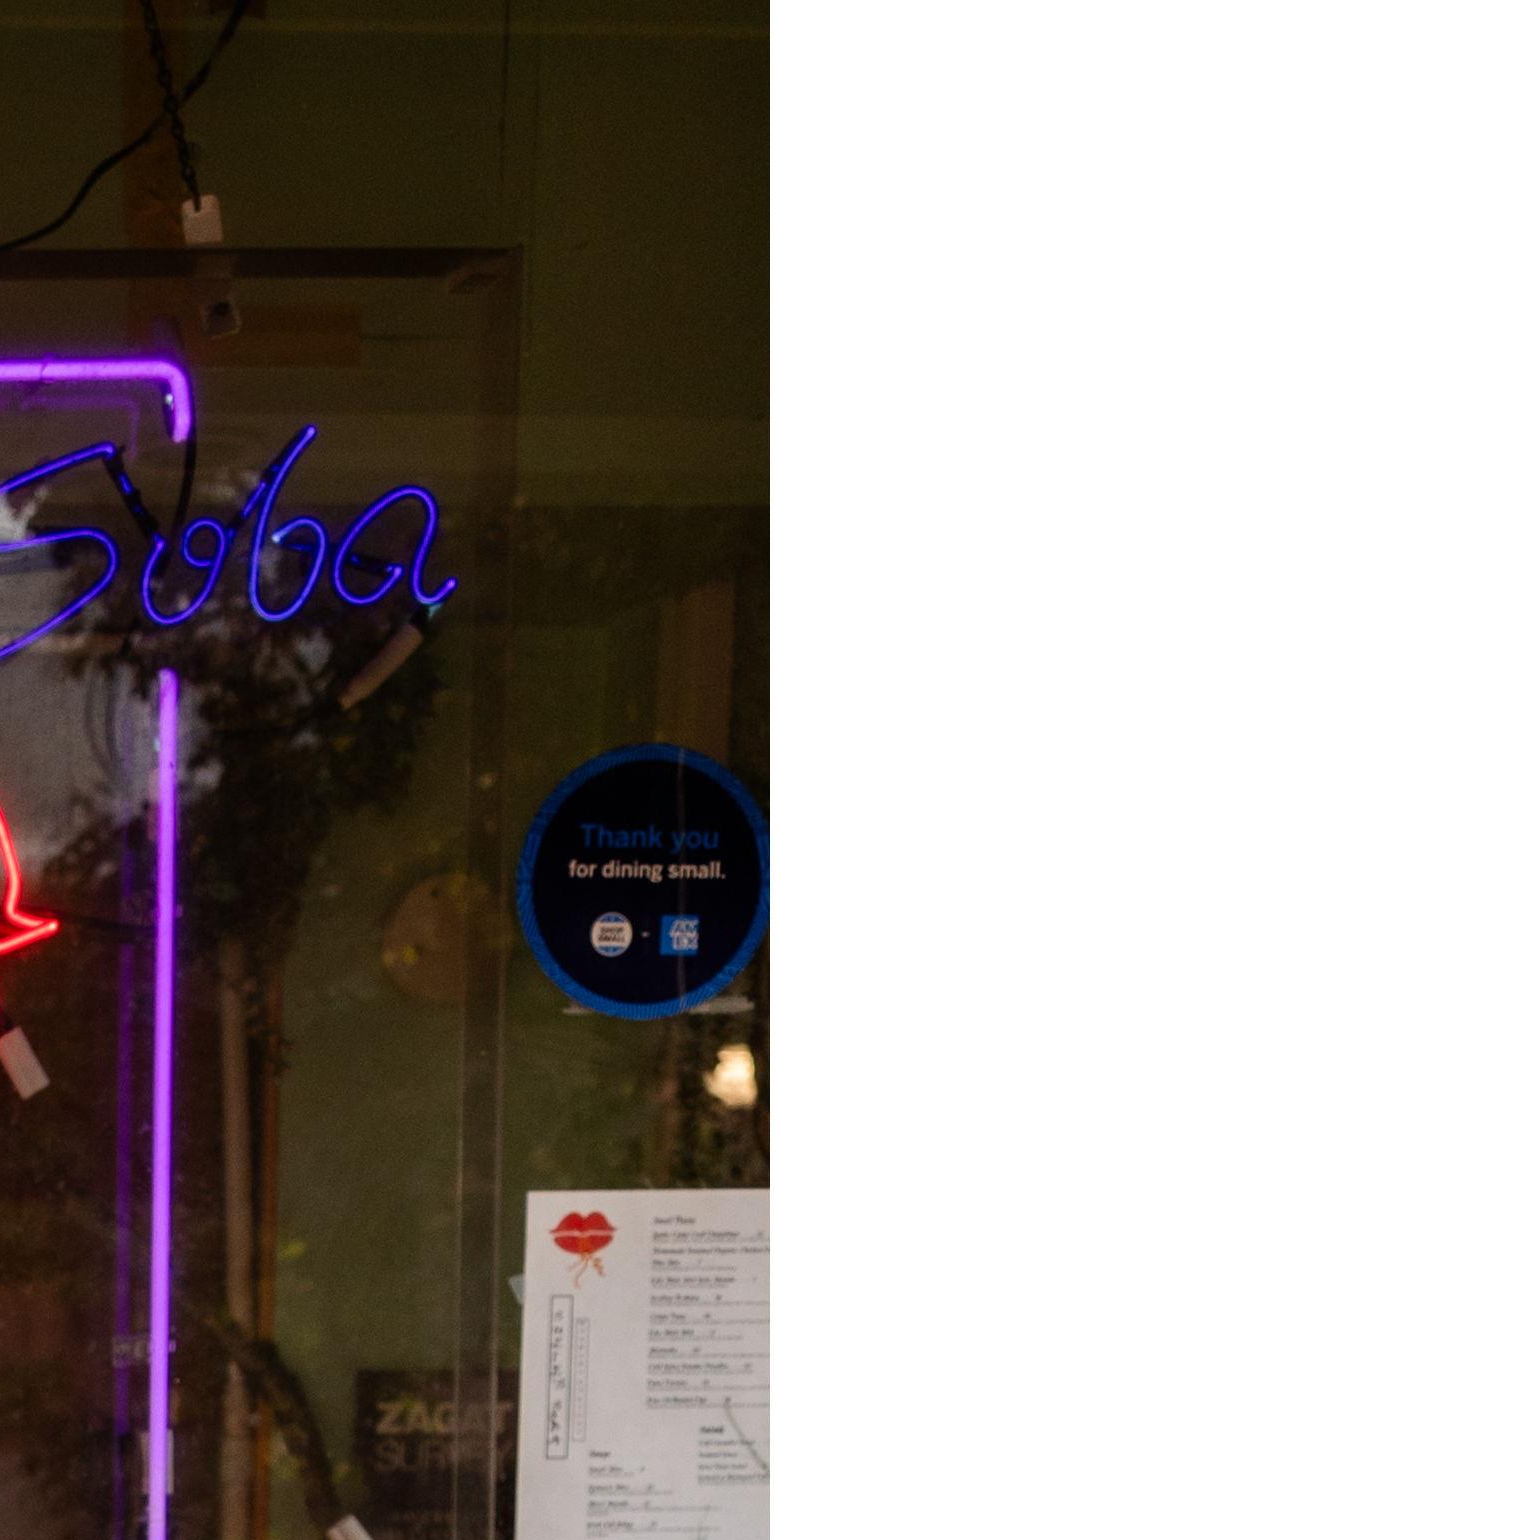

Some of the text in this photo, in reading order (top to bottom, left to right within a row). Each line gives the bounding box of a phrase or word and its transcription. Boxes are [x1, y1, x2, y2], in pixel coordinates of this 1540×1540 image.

[579, 823, 719, 853] Thank you
[569, 860, 726, 883] for dining small.
